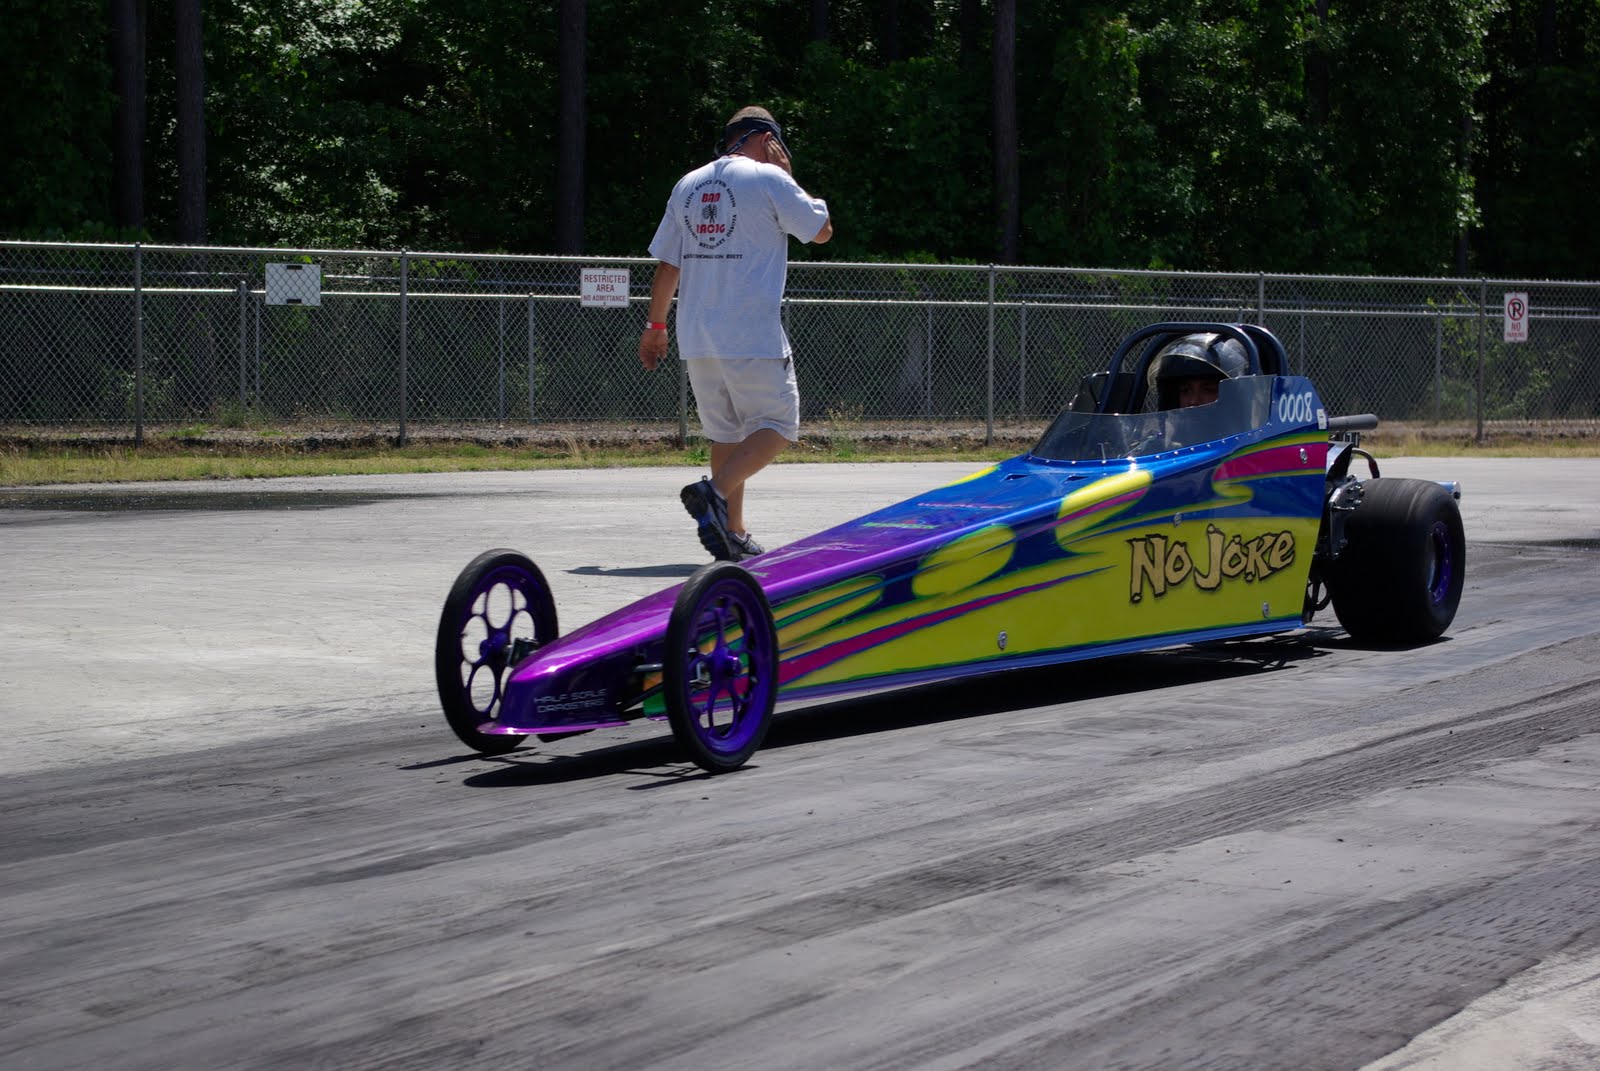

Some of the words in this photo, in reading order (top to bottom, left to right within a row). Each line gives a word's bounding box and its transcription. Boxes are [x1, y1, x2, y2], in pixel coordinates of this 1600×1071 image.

[584, 274, 627, 284] RESTRICTED
[595, 284, 615, 292] AREA
[1511, 321, 1521, 331] NO
[1279, 391, 1313, 423] 0008
[534, 693, 568, 704] HALF
[571, 688, 607, 700] SCALE
